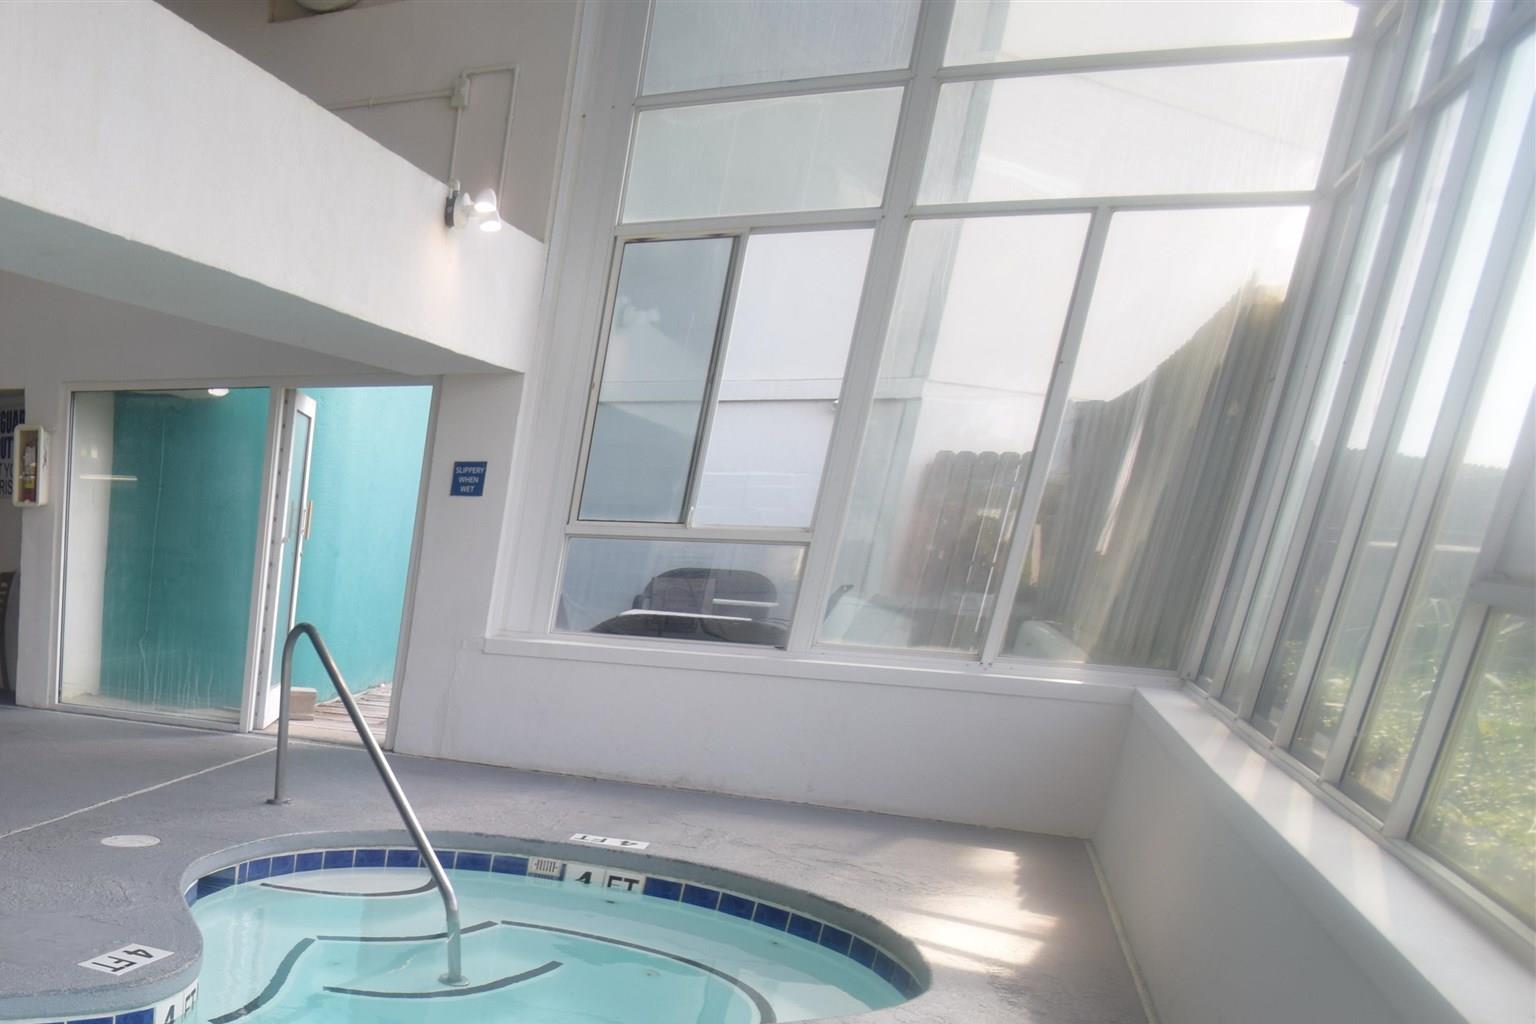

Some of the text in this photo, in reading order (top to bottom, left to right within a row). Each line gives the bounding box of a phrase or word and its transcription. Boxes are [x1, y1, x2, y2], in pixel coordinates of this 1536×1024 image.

[455, 466, 484, 474] SLIPPERY
[458, 476, 480, 484] WHEN
[0, 479, 13, 495] RIS
[459, 485, 475, 493] WET
[576, 871, 640, 891] 4 FT
[91, 948, 154, 972] 4 FT
